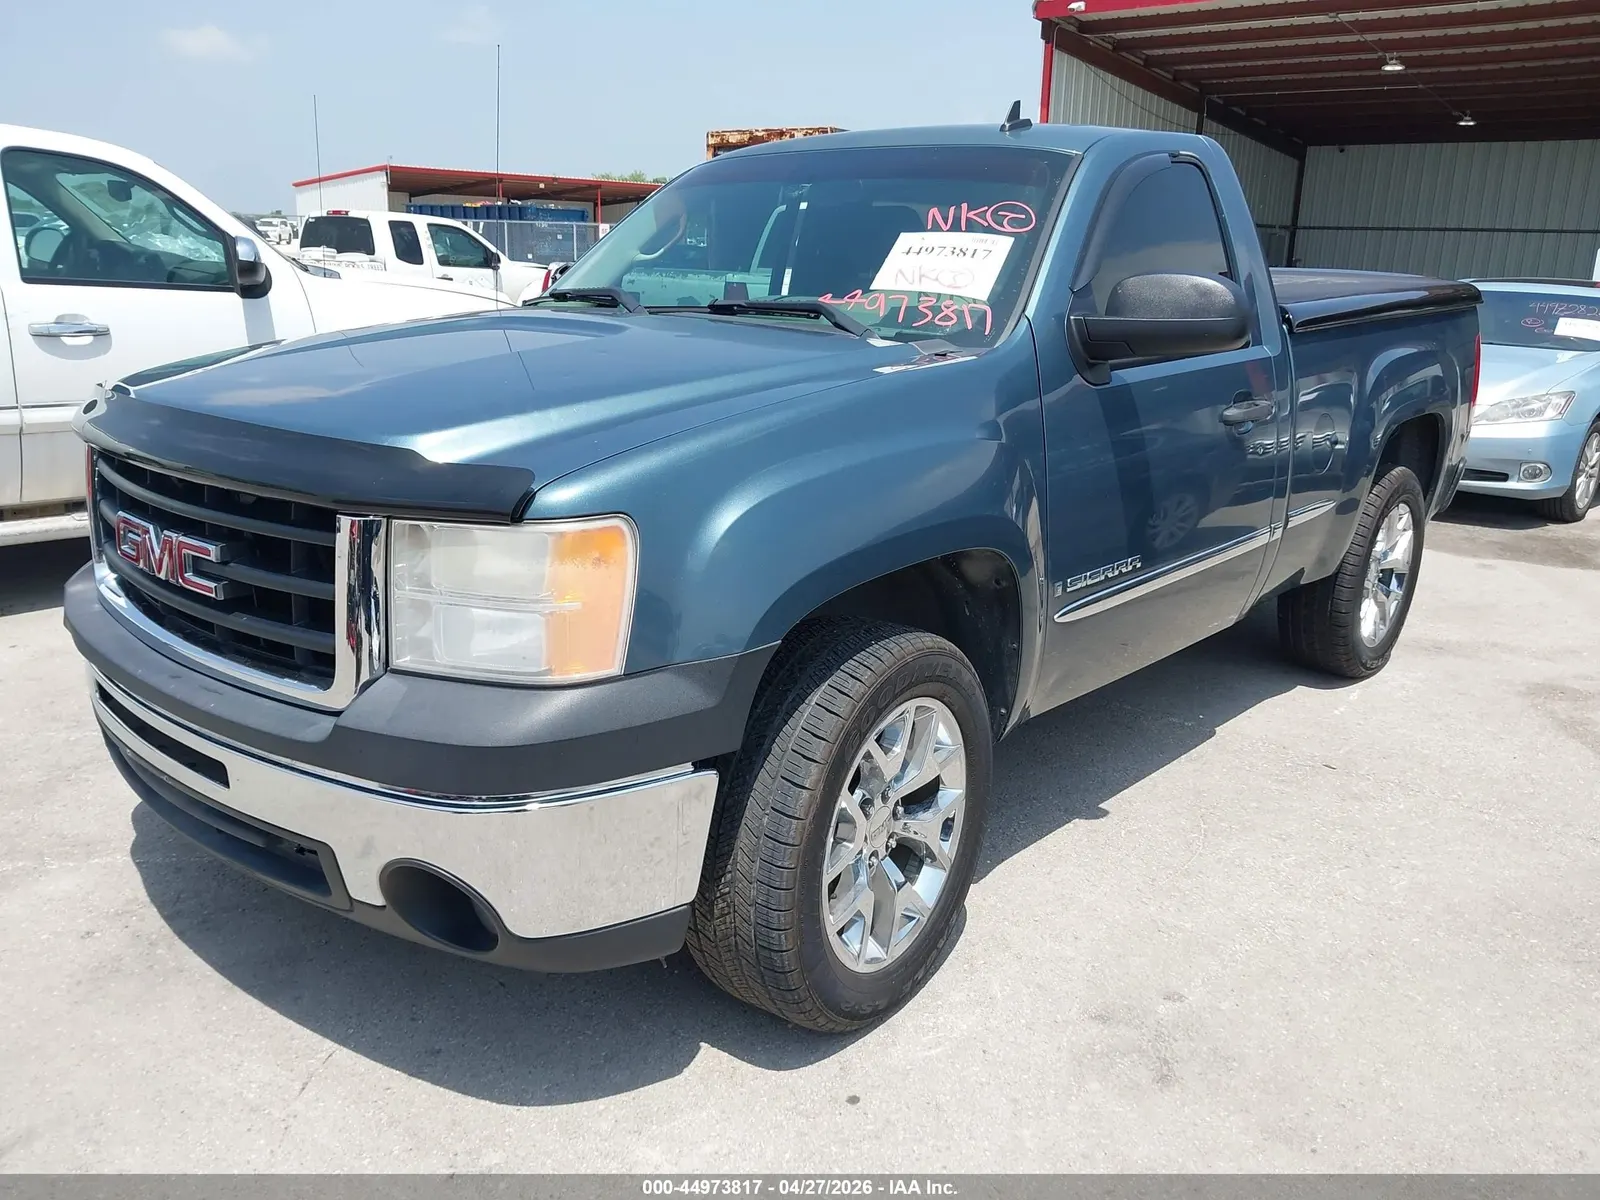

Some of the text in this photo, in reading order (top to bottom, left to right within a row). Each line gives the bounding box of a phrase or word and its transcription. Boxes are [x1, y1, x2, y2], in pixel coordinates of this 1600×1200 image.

[901, 245, 993, 260] 44973817
[1529, 301, 1600, 317] 4497282
[115, 510, 227, 600] GMC
[1066, 554, 1142, 592] SIERRA
